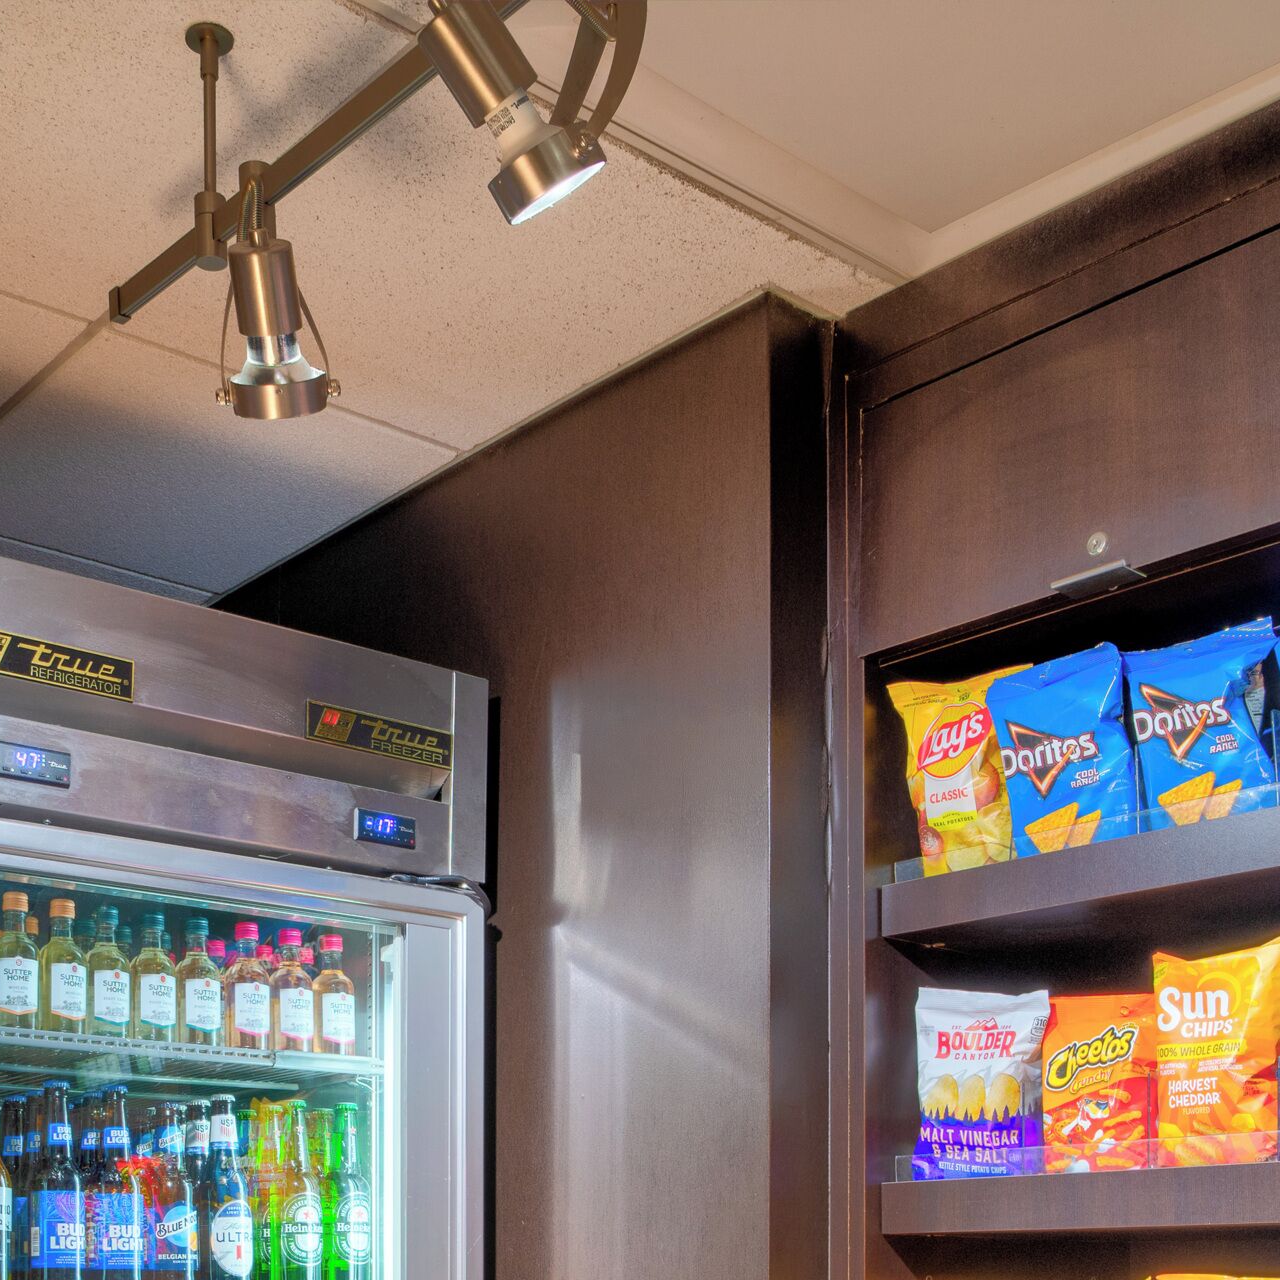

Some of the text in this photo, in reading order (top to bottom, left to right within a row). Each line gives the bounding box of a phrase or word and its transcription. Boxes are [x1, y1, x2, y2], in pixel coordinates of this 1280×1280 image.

[30, 665, 121, 695] REFRIGERATOR
[1134, 698, 1228, 740] Doritos
[1209, 741, 1239, 754] RANCH
[1215, 734, 1235, 745] COOL
[371, 739, 443, 764] FREEZER
[929, 788, 969, 804] CLASSIC
[1157, 987, 1229, 1032] Sun
[1181, 1019, 1233, 1038] CHIPS
[935, 1031, 1016, 1060] BOULDER
[1180, 1042, 1241, 1057] WHOLE GRAIN
[955, 1052, 995, 1061] CANYON
[1047, 1028, 1134, 1089] Cheetos
[1168, 1078, 1218, 1094] HARVEST
[1169, 1093, 1221, 1108] CHEDDAR
[921, 1127, 1019, 1147] MALT VINEGAR
[932, 1144, 1008, 1163] & SEA SALT
[938, 1161, 970, 1172] KETTLE STYLE
